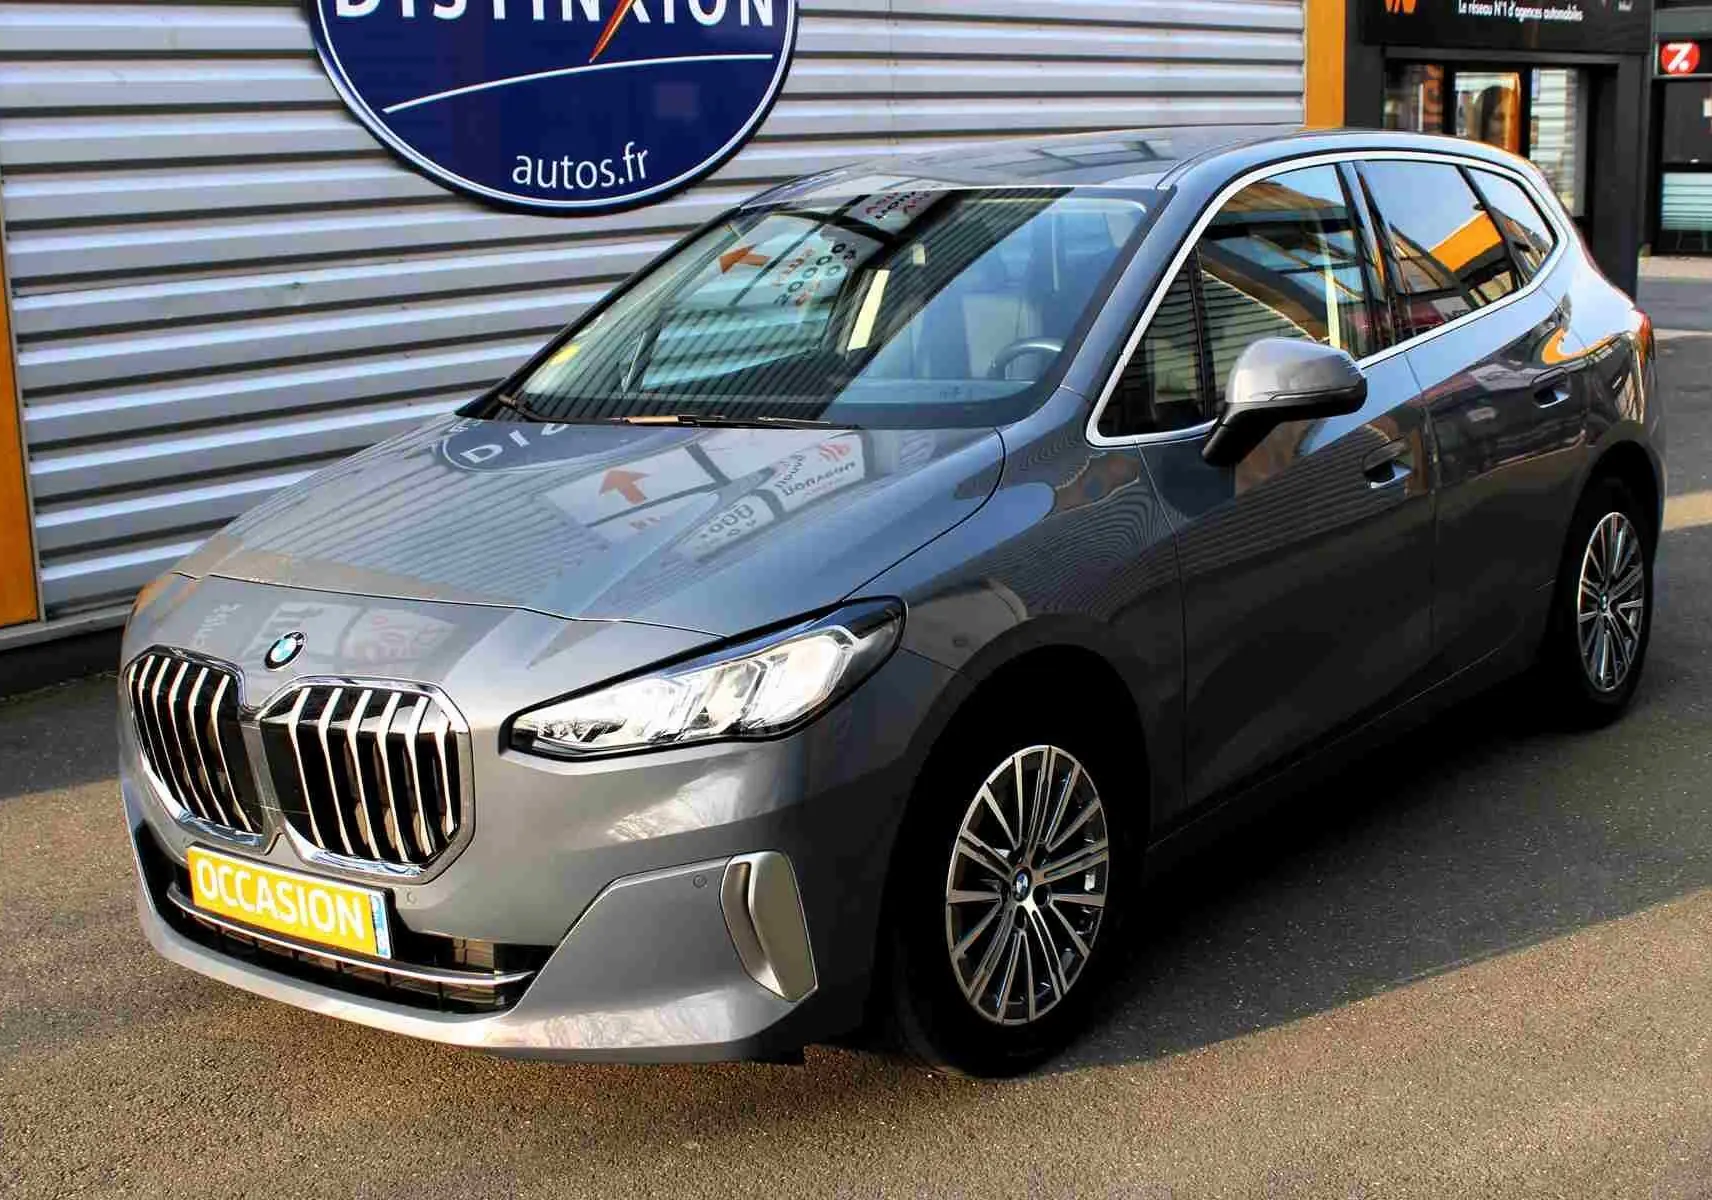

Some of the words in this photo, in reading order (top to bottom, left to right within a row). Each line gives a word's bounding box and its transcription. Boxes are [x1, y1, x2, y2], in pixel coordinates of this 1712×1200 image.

[1543, 4, 1583, 21] automobiles
[512, 141, 648, 189] autos.fr
[195, 860, 366, 941] OCCASION
